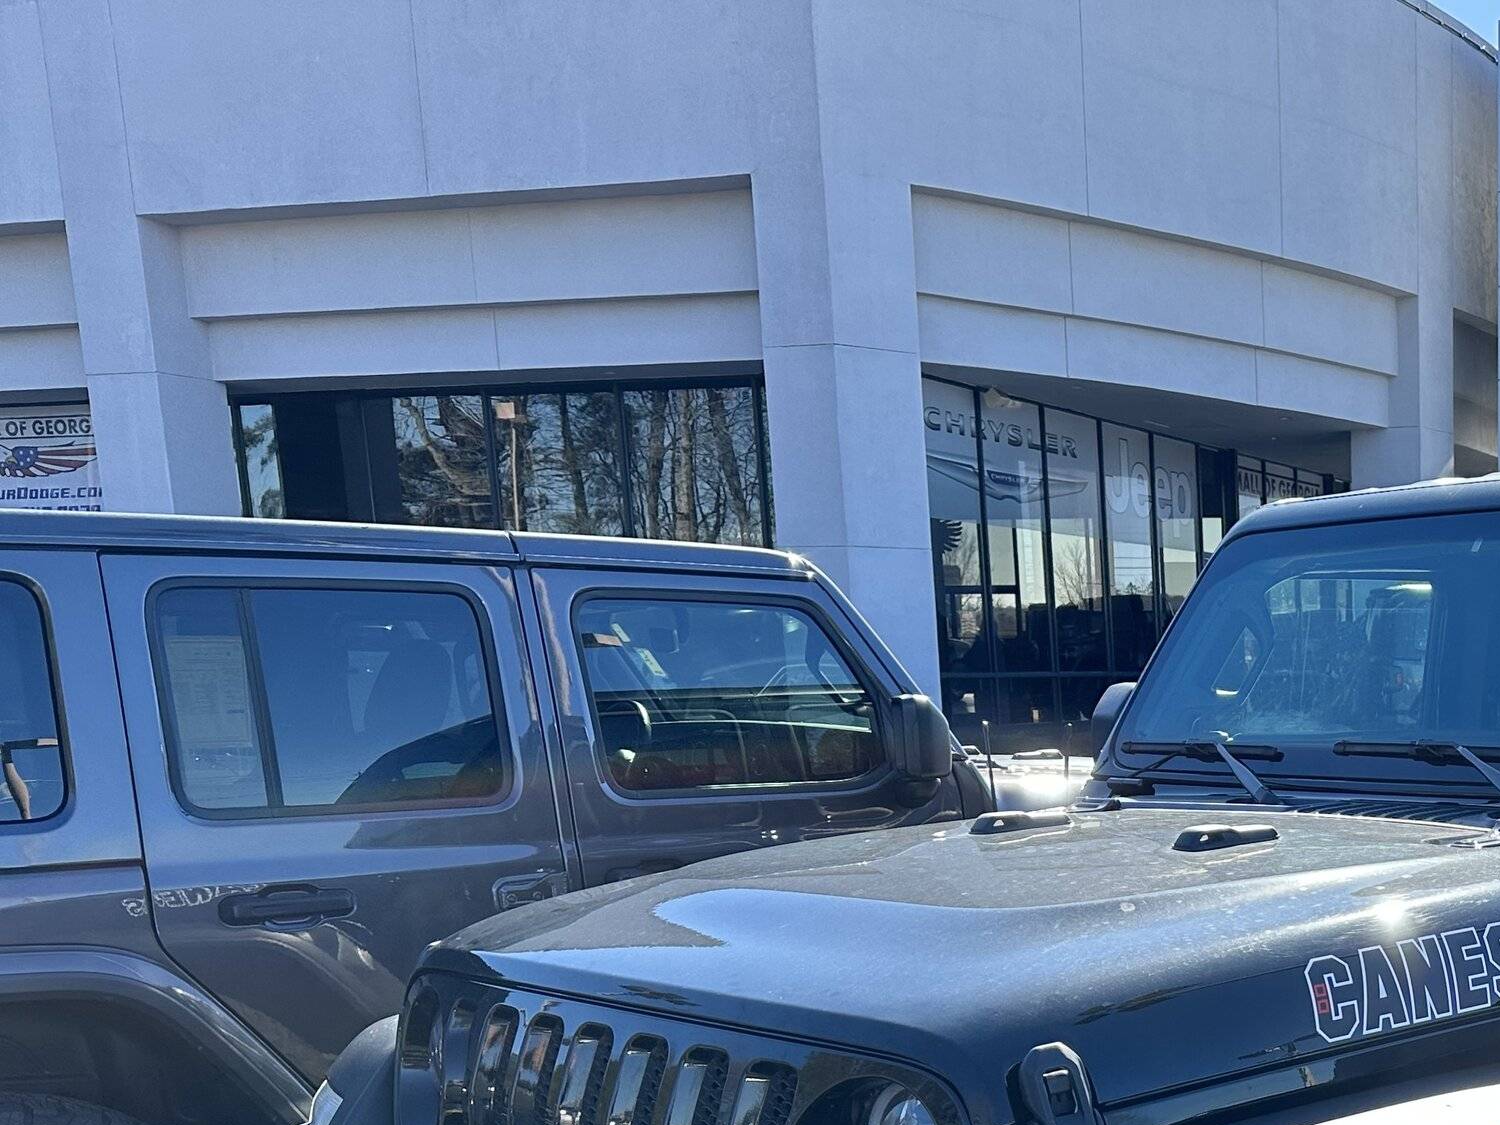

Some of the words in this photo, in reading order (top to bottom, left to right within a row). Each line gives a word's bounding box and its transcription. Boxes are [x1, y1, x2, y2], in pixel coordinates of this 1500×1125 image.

[5, 420, 27, 436] OF
[923, 405, 1080, 459] CHRYSLER
[1106, 438, 1193, 540] Jeep
